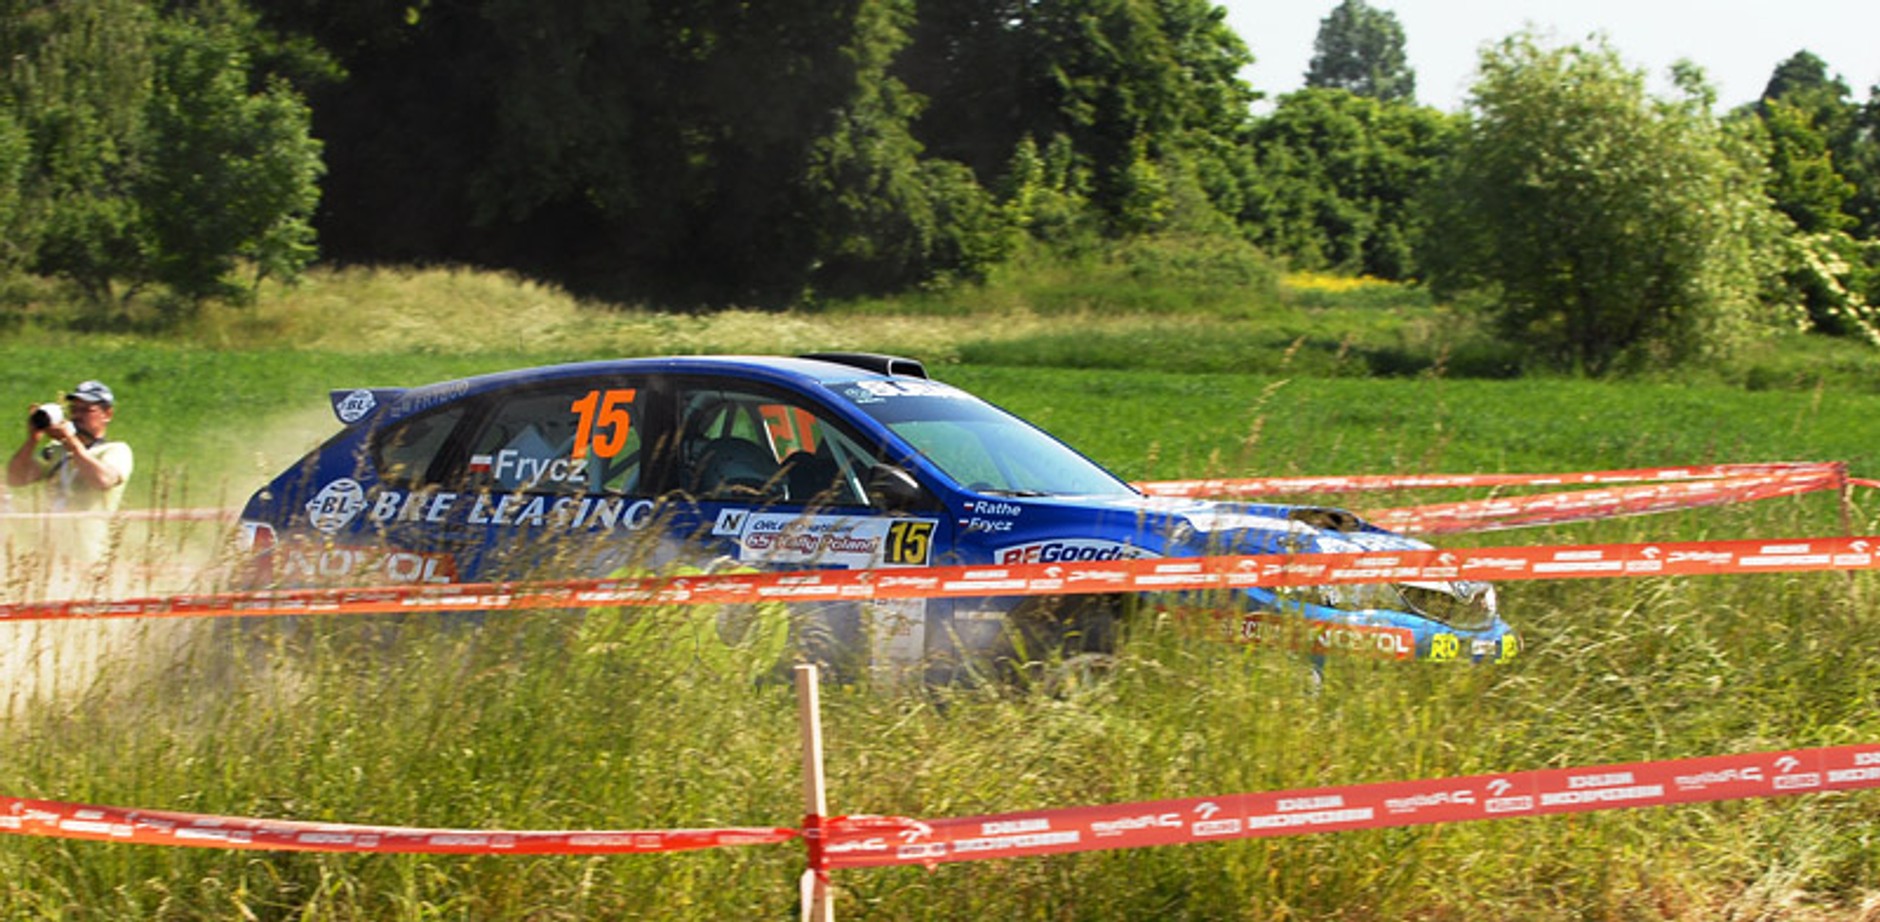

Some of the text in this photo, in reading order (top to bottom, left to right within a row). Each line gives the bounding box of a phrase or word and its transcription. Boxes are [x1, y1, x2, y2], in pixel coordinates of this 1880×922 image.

[571, 388, 636, 459] 15
[494, 449, 588, 488] Frycz
[321, 496, 350, 514] BL
[371, 491, 457, 522] BRE
[975, 501, 1021, 516] Rathe
[721, 513, 742, 530] N
[968, 517, 1013, 533] Frycz
[889, 522, 932, 564] 15
